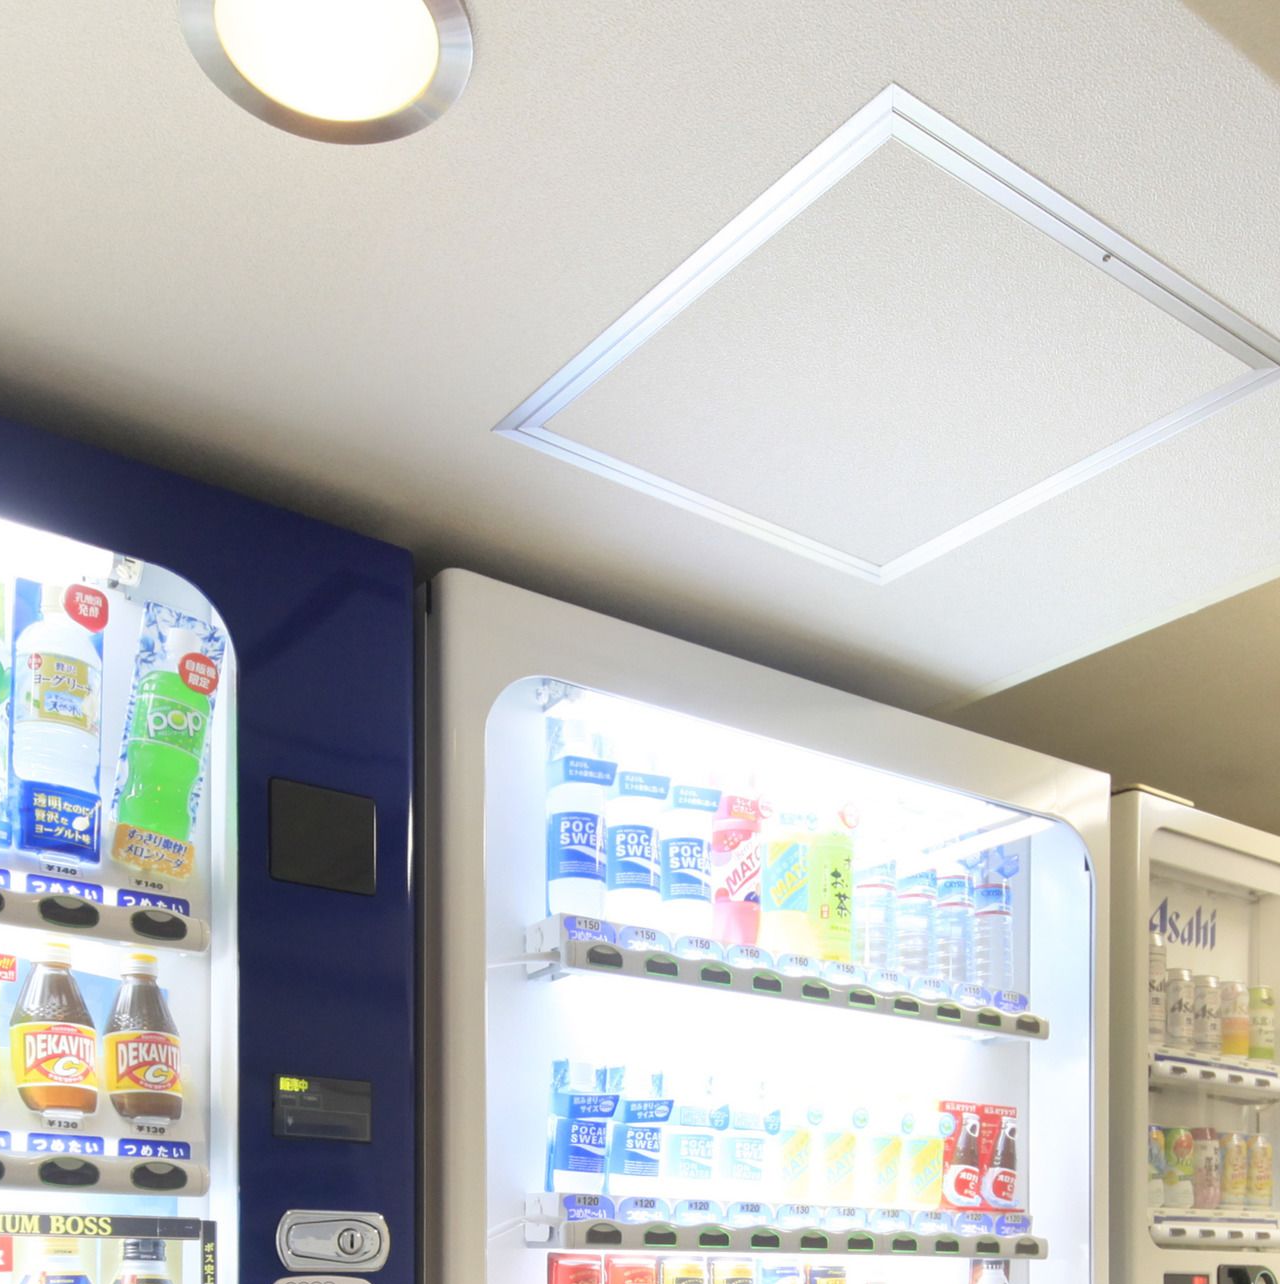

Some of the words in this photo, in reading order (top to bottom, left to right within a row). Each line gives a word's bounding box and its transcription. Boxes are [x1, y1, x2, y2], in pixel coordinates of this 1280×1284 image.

[77, 603, 101, 619] 発酵
[187, 672, 213, 691] 限定
[146, 707, 204, 740] pop
[33, 824, 92, 846] ヨーグルト味
[126, 827, 189, 859] すっきり爽快!
[123, 843, 187, 871] メロンソーダ
[45, 864, 78, 877] ¥140
[133, 878, 165, 891] ¥140
[1149, 896, 1217, 951] Asahi
[54, 1056, 80, 1077] C
[143, 1064, 169, 1084] C
[32, 1137, 100, 1155] つめたい
[49, 1214, 113, 1237] BOSS
